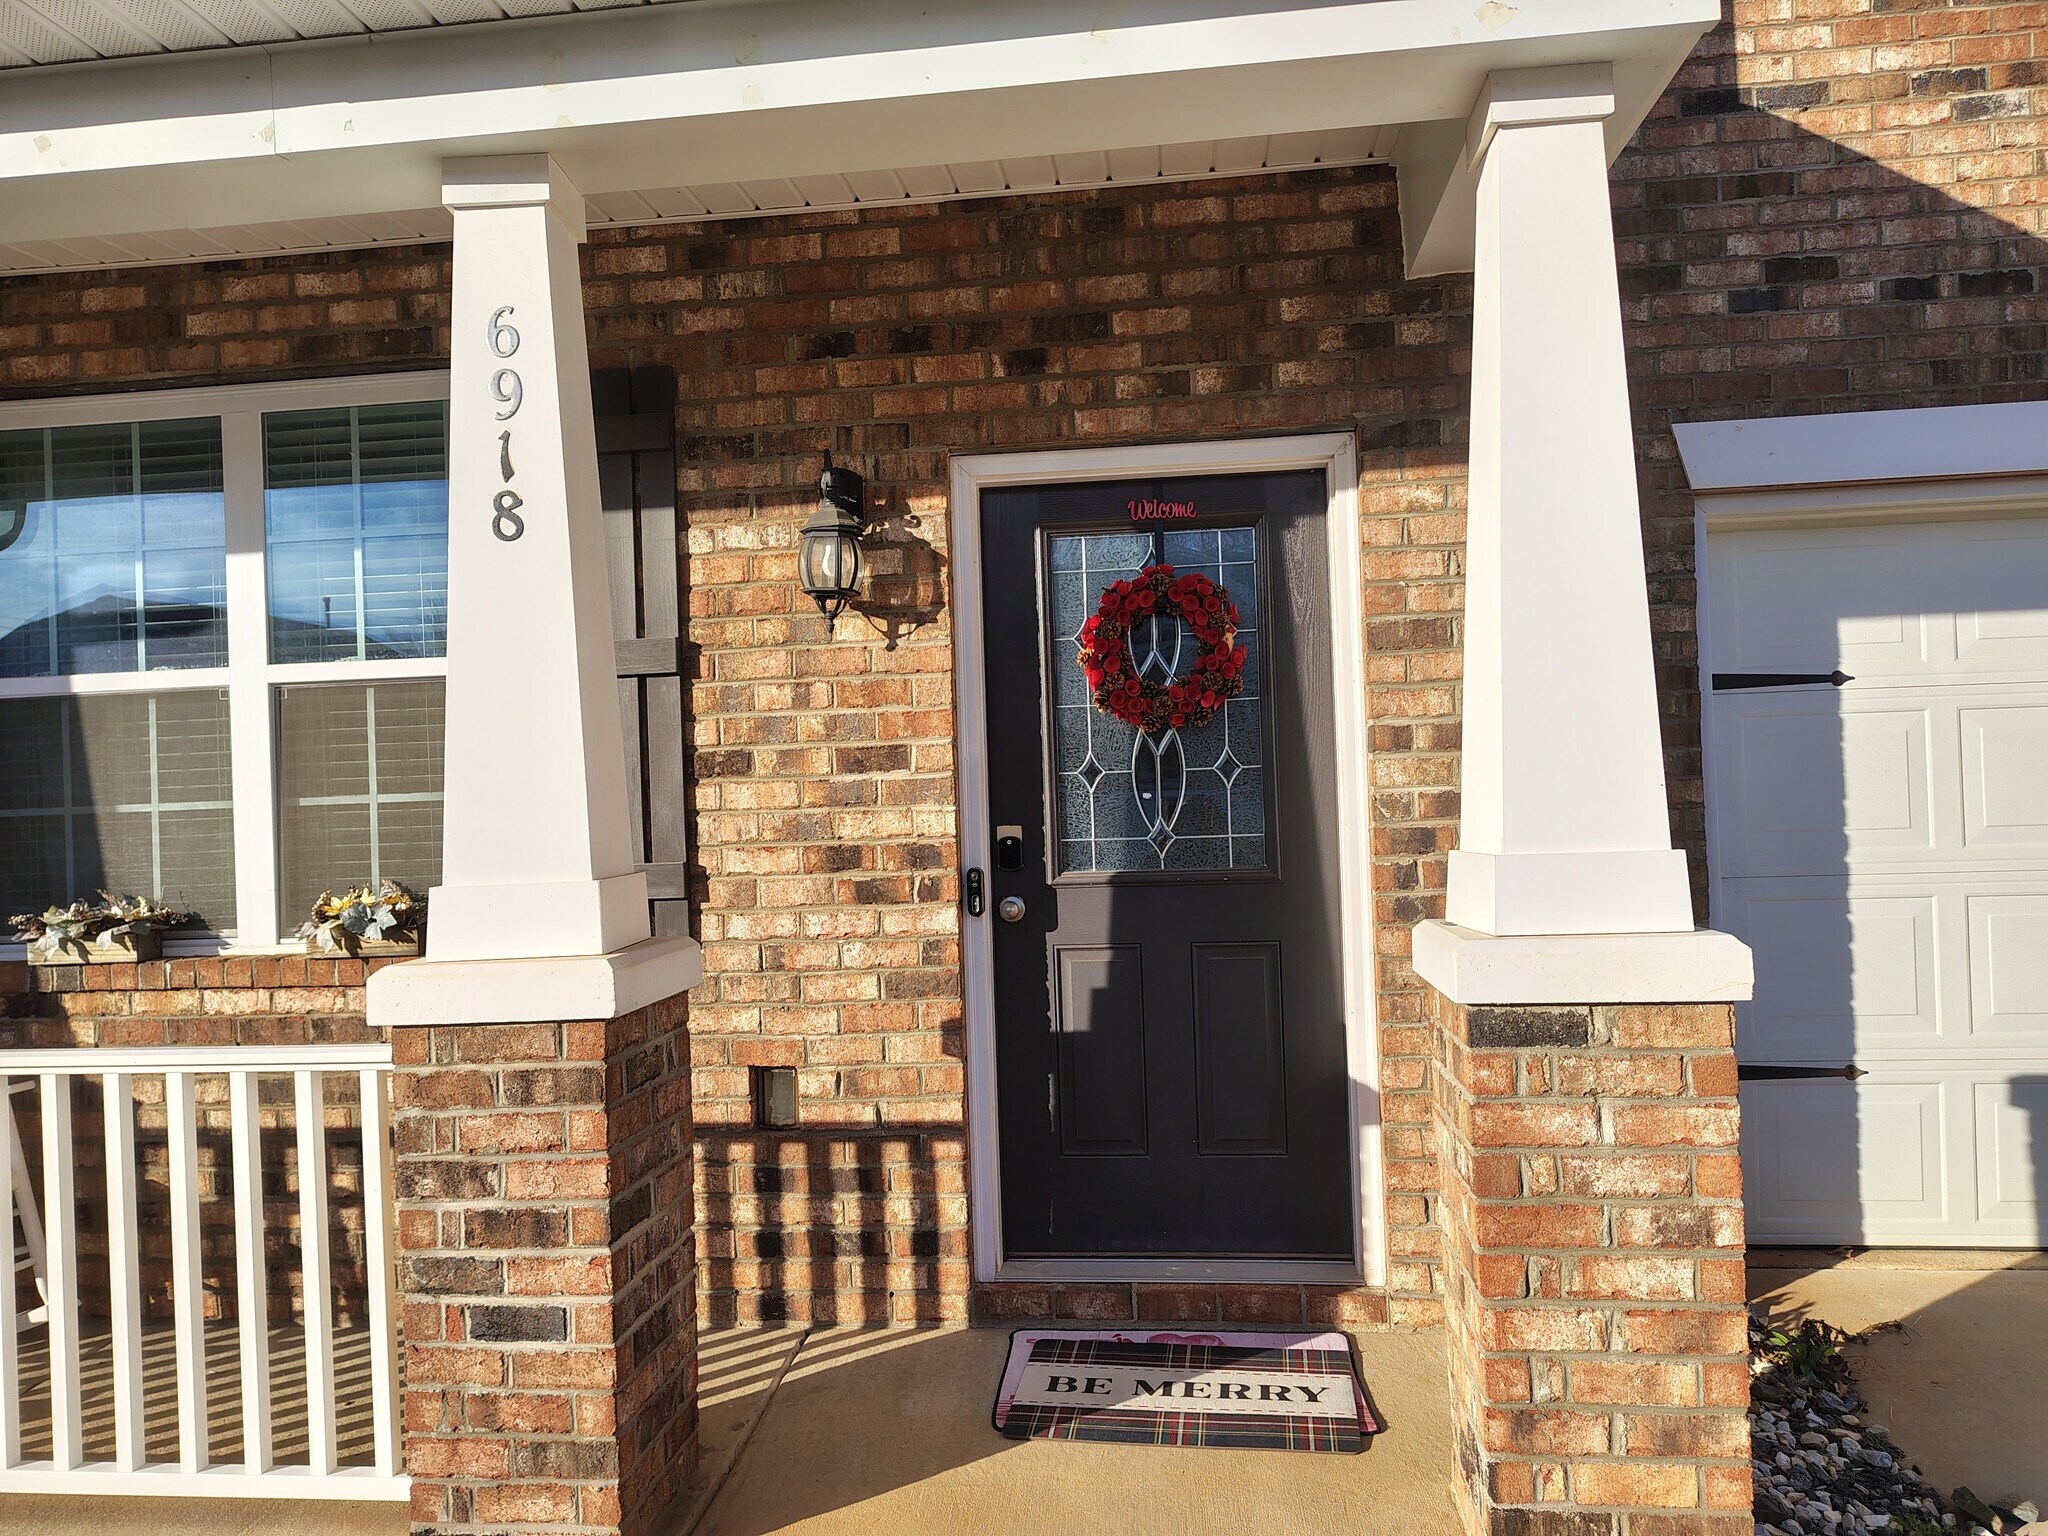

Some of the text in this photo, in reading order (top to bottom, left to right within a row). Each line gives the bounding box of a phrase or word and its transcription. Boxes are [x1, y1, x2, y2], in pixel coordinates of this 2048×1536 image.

[486, 305, 525, 542] 6918
[1127, 498, 1197, 521] Welcome
[1045, 1374, 1330, 1403] BE MERRY
